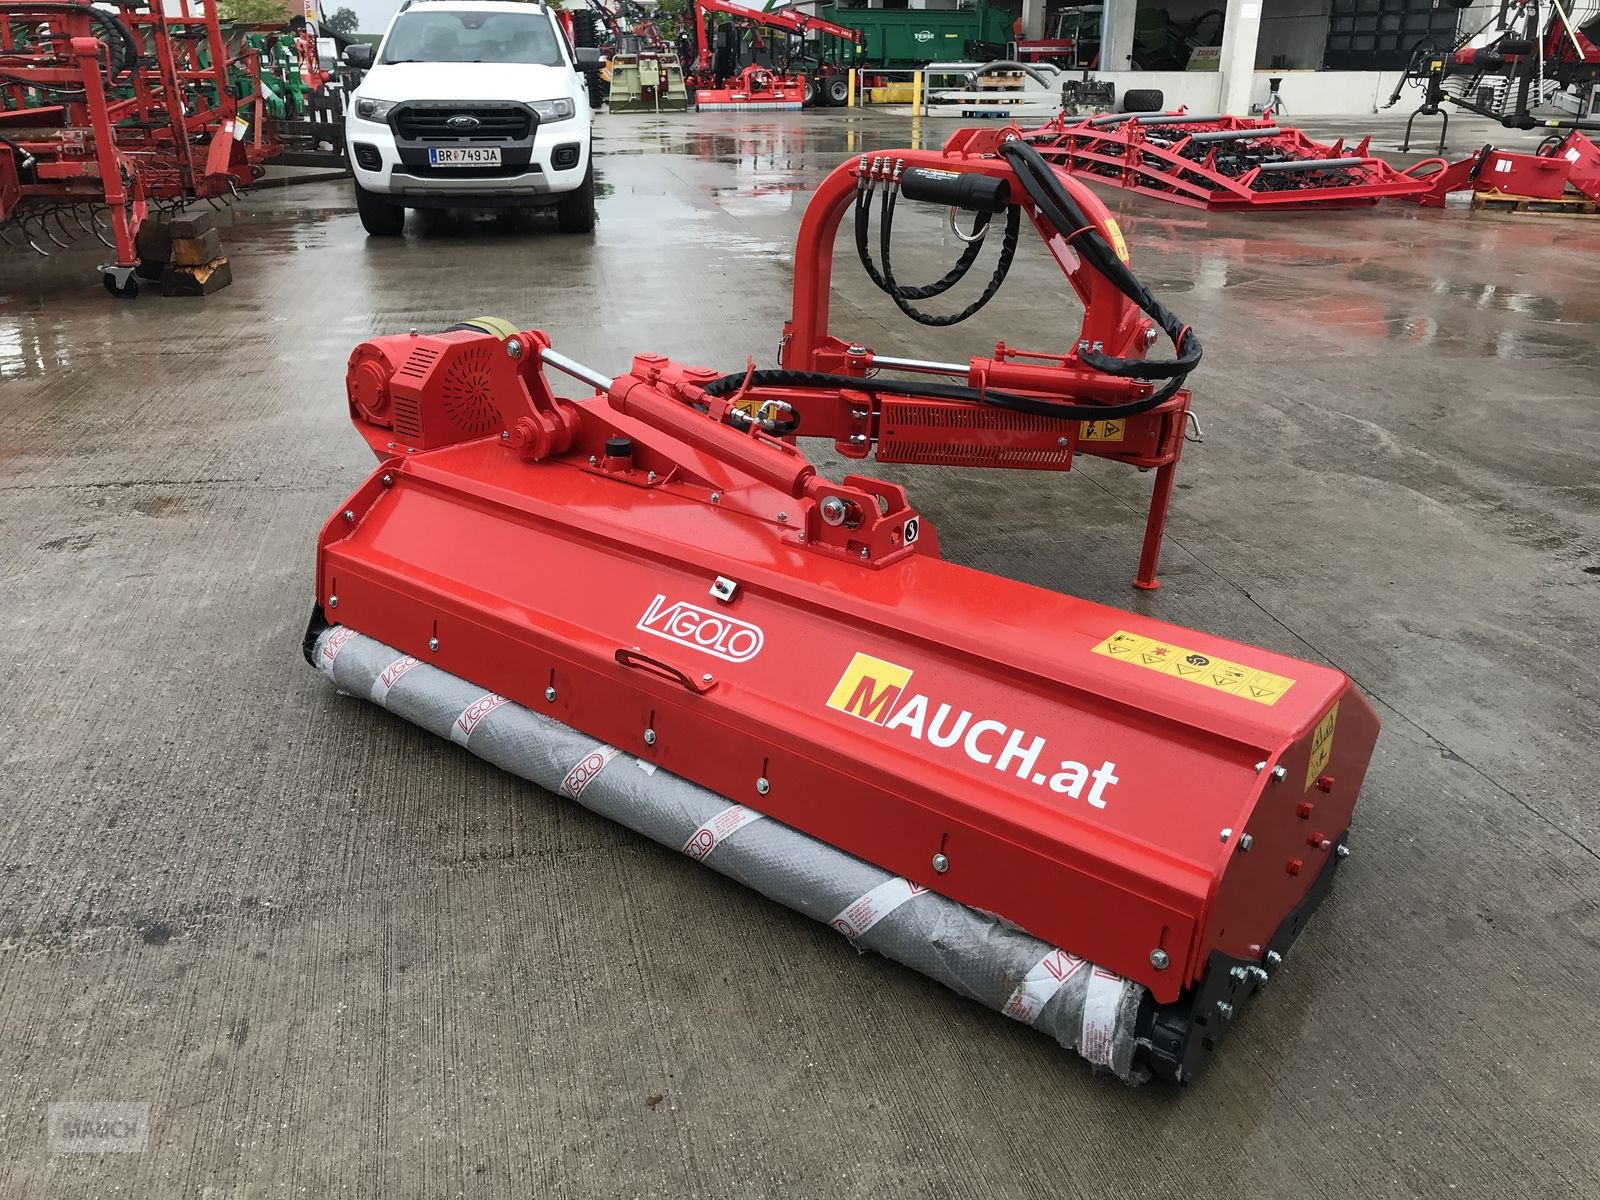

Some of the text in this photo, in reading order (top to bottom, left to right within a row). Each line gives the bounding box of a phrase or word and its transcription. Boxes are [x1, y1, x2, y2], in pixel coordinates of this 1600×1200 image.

[453, 118, 472, 127] Ford
[438, 150, 452, 161] BR
[636, 593, 764, 663] VIGOLO
[844, 674, 1120, 810] MAUCH.at
